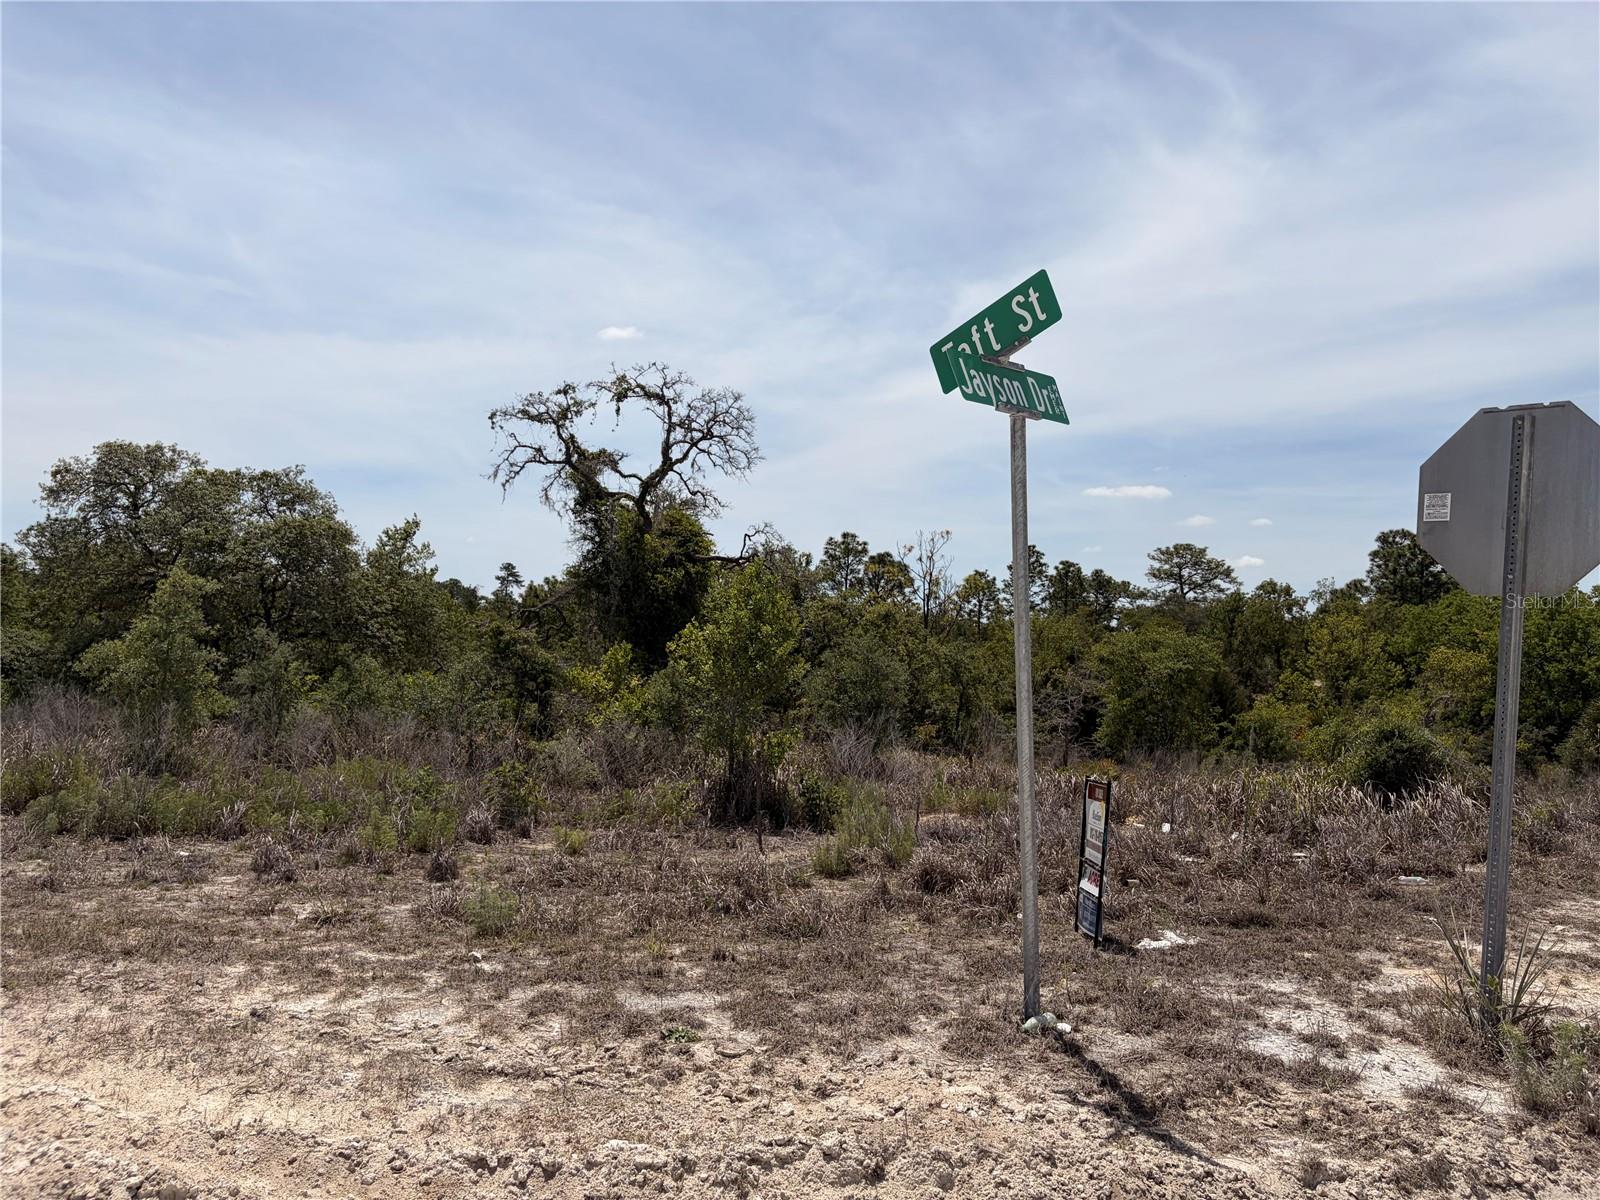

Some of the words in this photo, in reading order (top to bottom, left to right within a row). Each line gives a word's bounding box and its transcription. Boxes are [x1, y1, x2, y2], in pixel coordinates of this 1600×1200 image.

[1011, 286, 1047, 333] St
[959, 357, 1029, 408] Jayson
[1026, 376, 1053, 415] Dr
